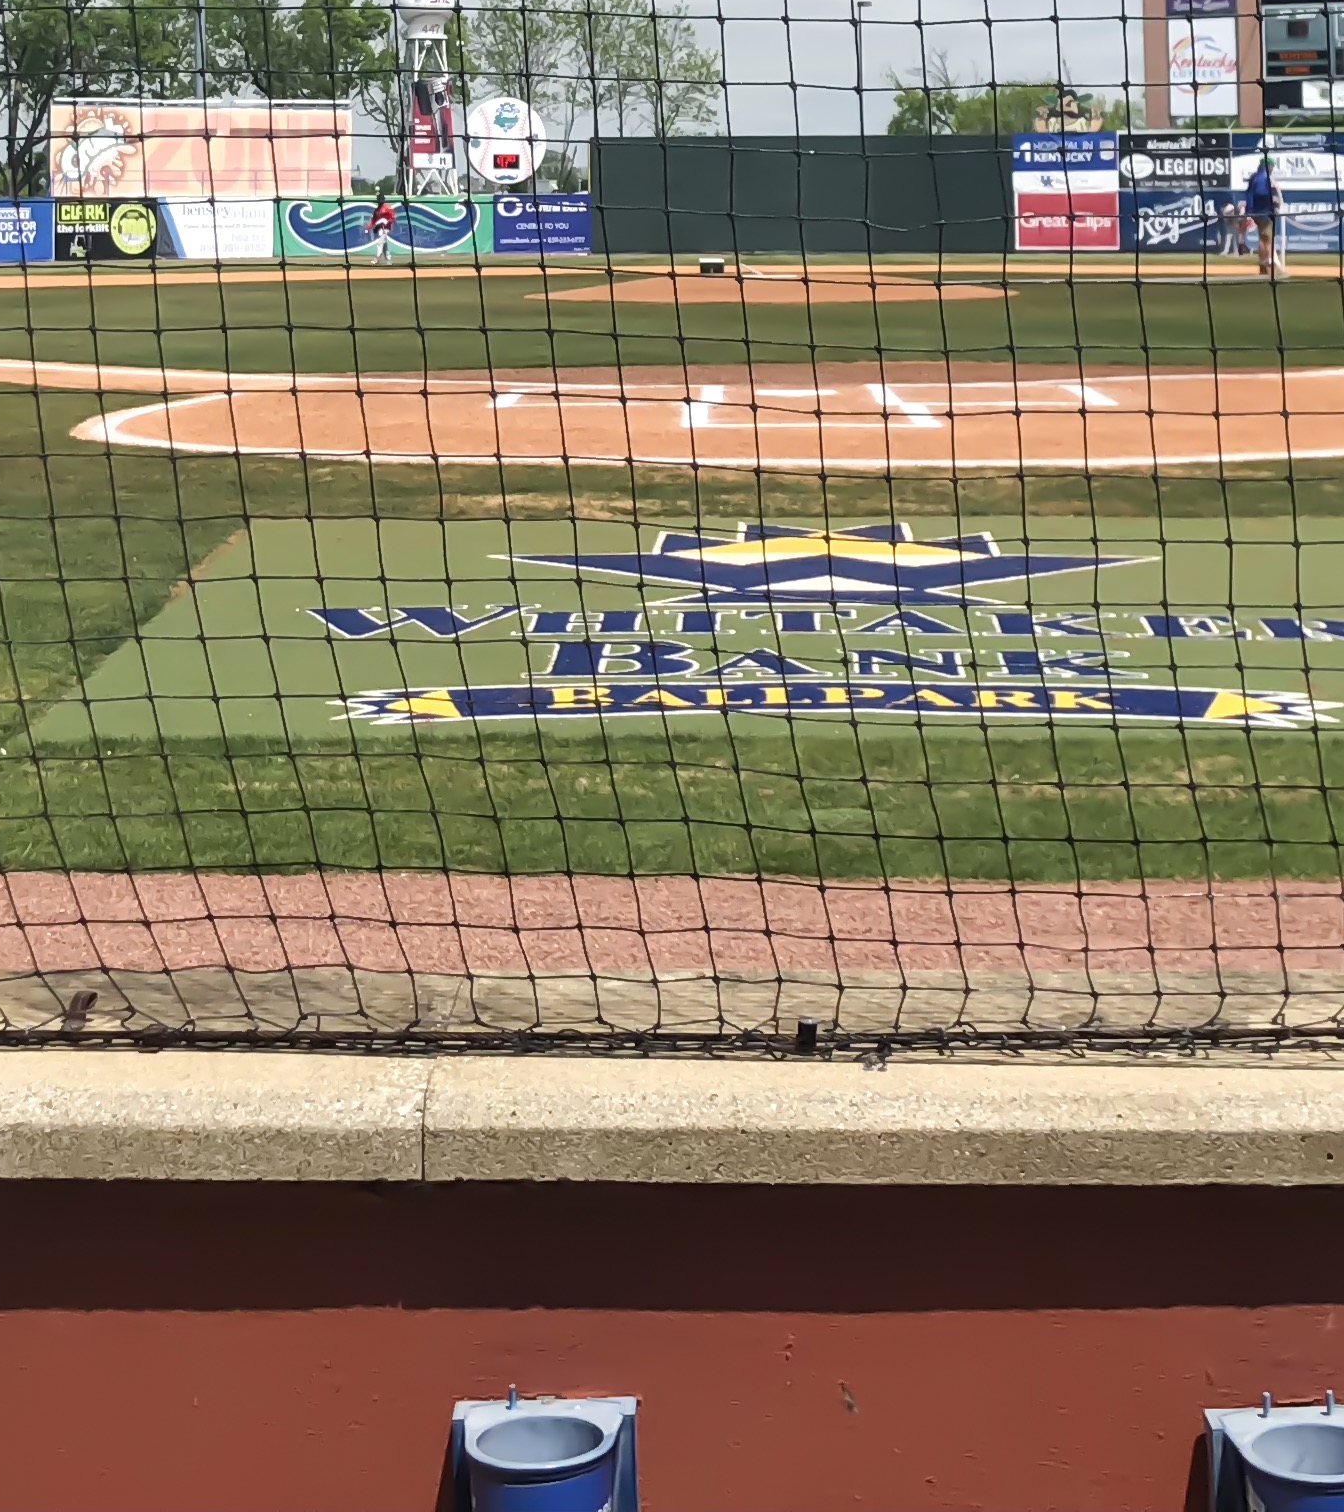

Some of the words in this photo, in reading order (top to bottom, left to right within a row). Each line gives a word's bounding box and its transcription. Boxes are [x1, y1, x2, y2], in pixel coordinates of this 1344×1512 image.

[421, 24, 441, 34] 447
[146, 113, 350, 193] ZONE
[1155, 157, 1230, 176] LEGENDS!
[61, 204, 105, 220] CLARK
[1020, 211, 1069, 228] Great
[1073, 211, 1112, 232] Clips
[520, 638, 1149, 679] BANK
[545, 686, 1117, 711] BALLPARK
